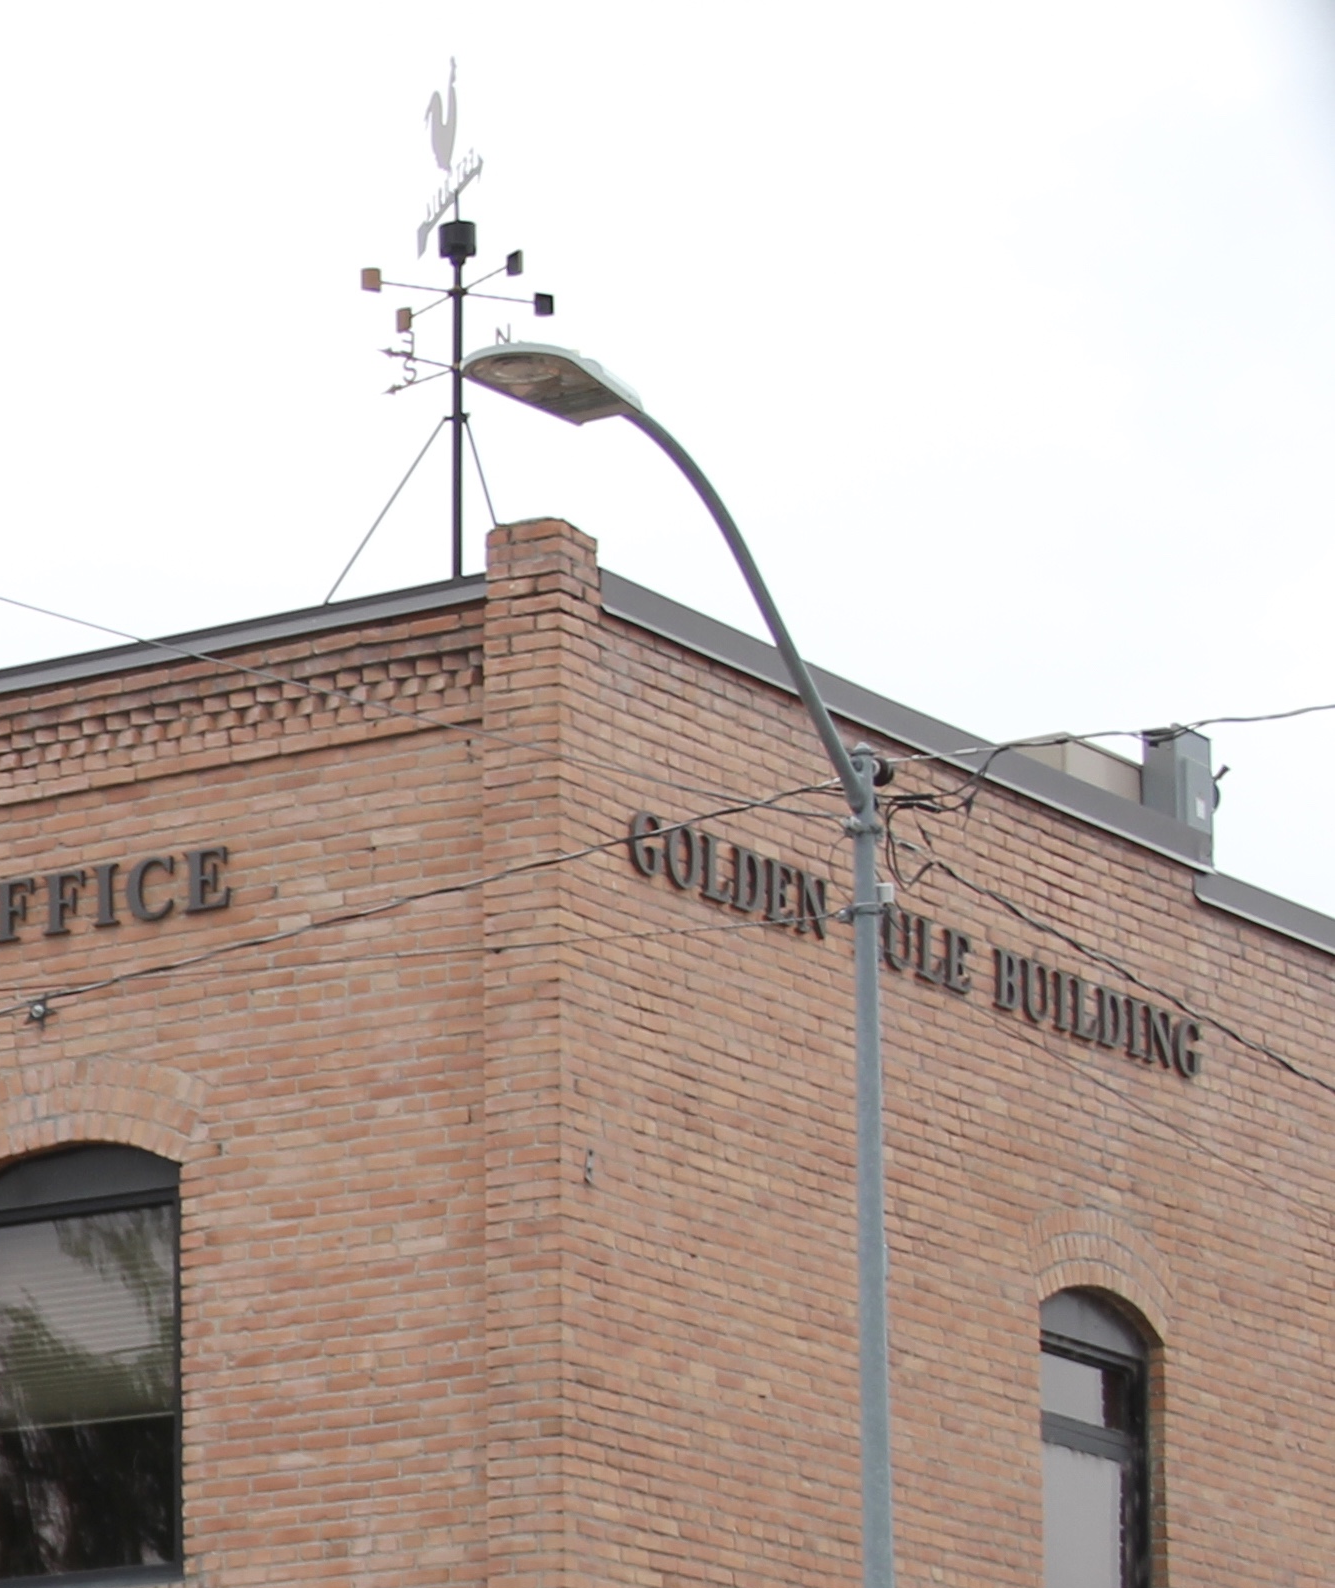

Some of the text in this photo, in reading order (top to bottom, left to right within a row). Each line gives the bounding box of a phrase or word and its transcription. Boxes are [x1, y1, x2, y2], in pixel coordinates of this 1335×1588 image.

[630, 810, 1202, 1078] GOLDEN ULE BUILDING
